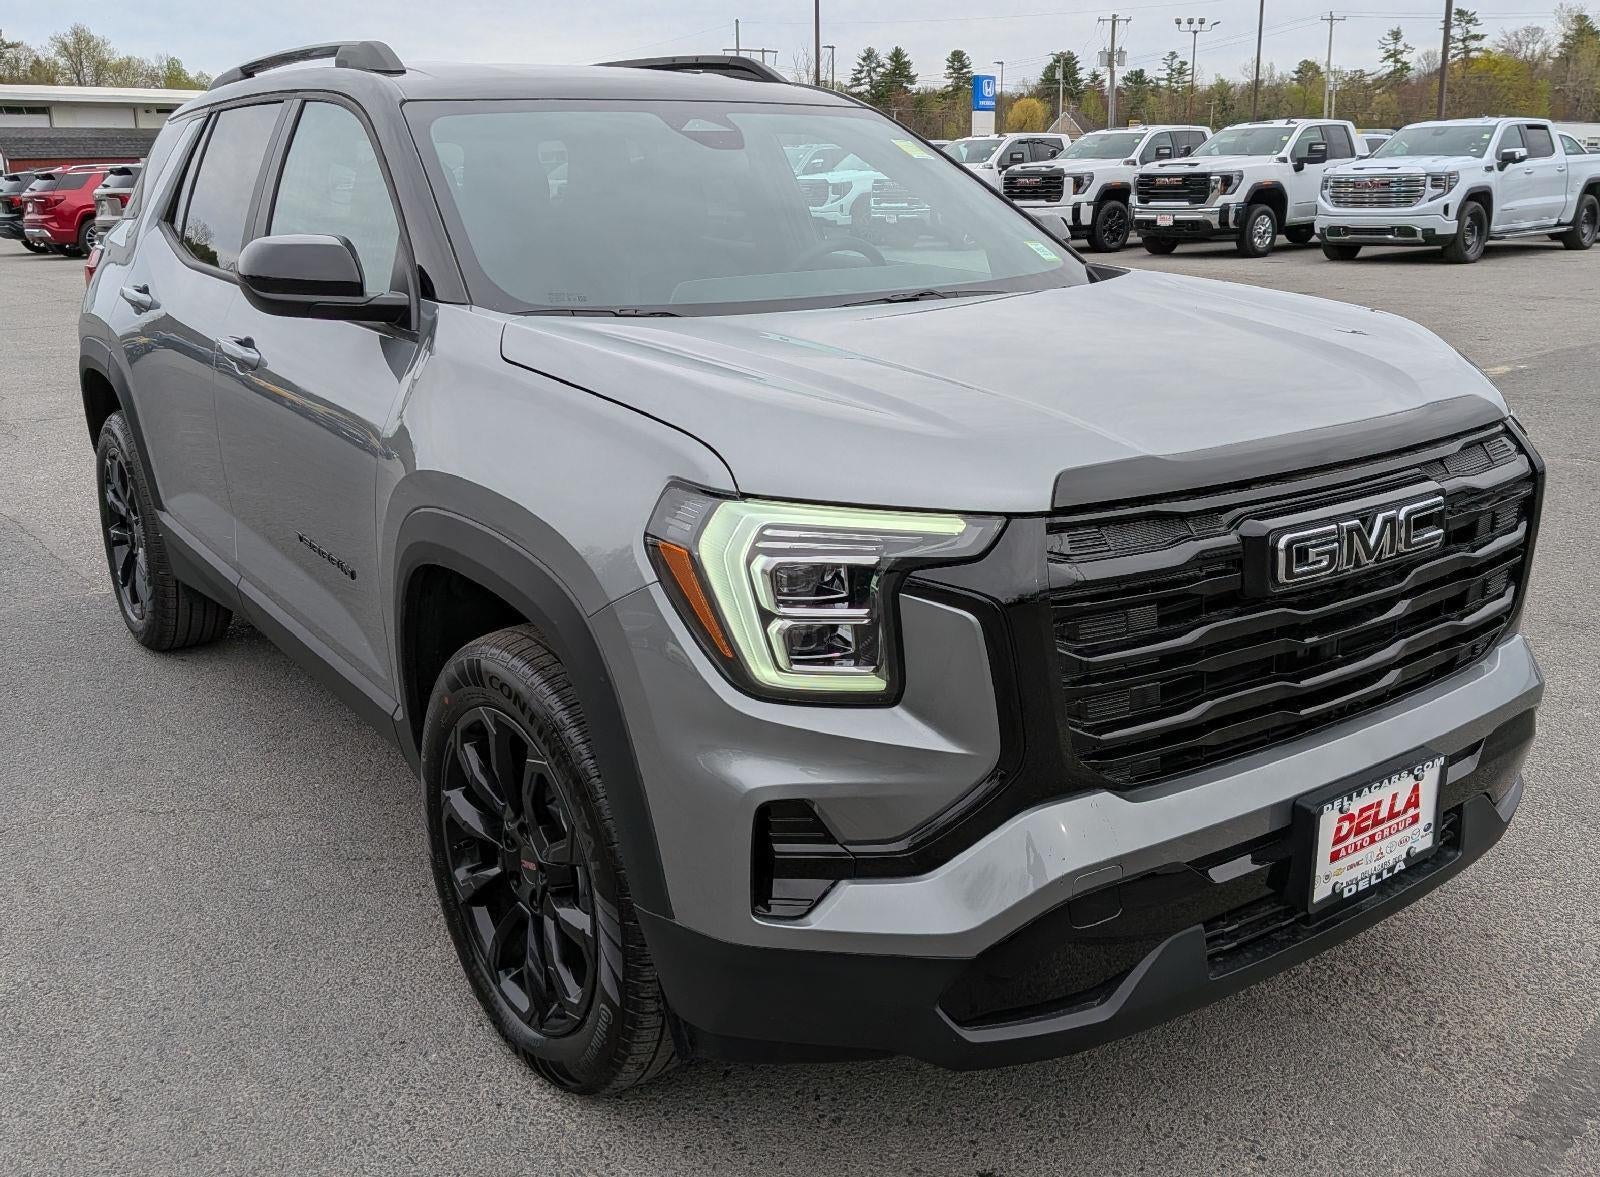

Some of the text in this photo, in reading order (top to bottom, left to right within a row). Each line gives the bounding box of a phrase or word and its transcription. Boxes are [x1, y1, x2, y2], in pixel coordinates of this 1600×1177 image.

[1277, 495, 1444, 583] GMC
[1323, 756, 1445, 814] DELLACARS.COM
[1332, 782, 1420, 848] DELLA
[1339, 817, 1412, 857] AUTO GROUP
[1343, 861, 1406, 899] DELLA
